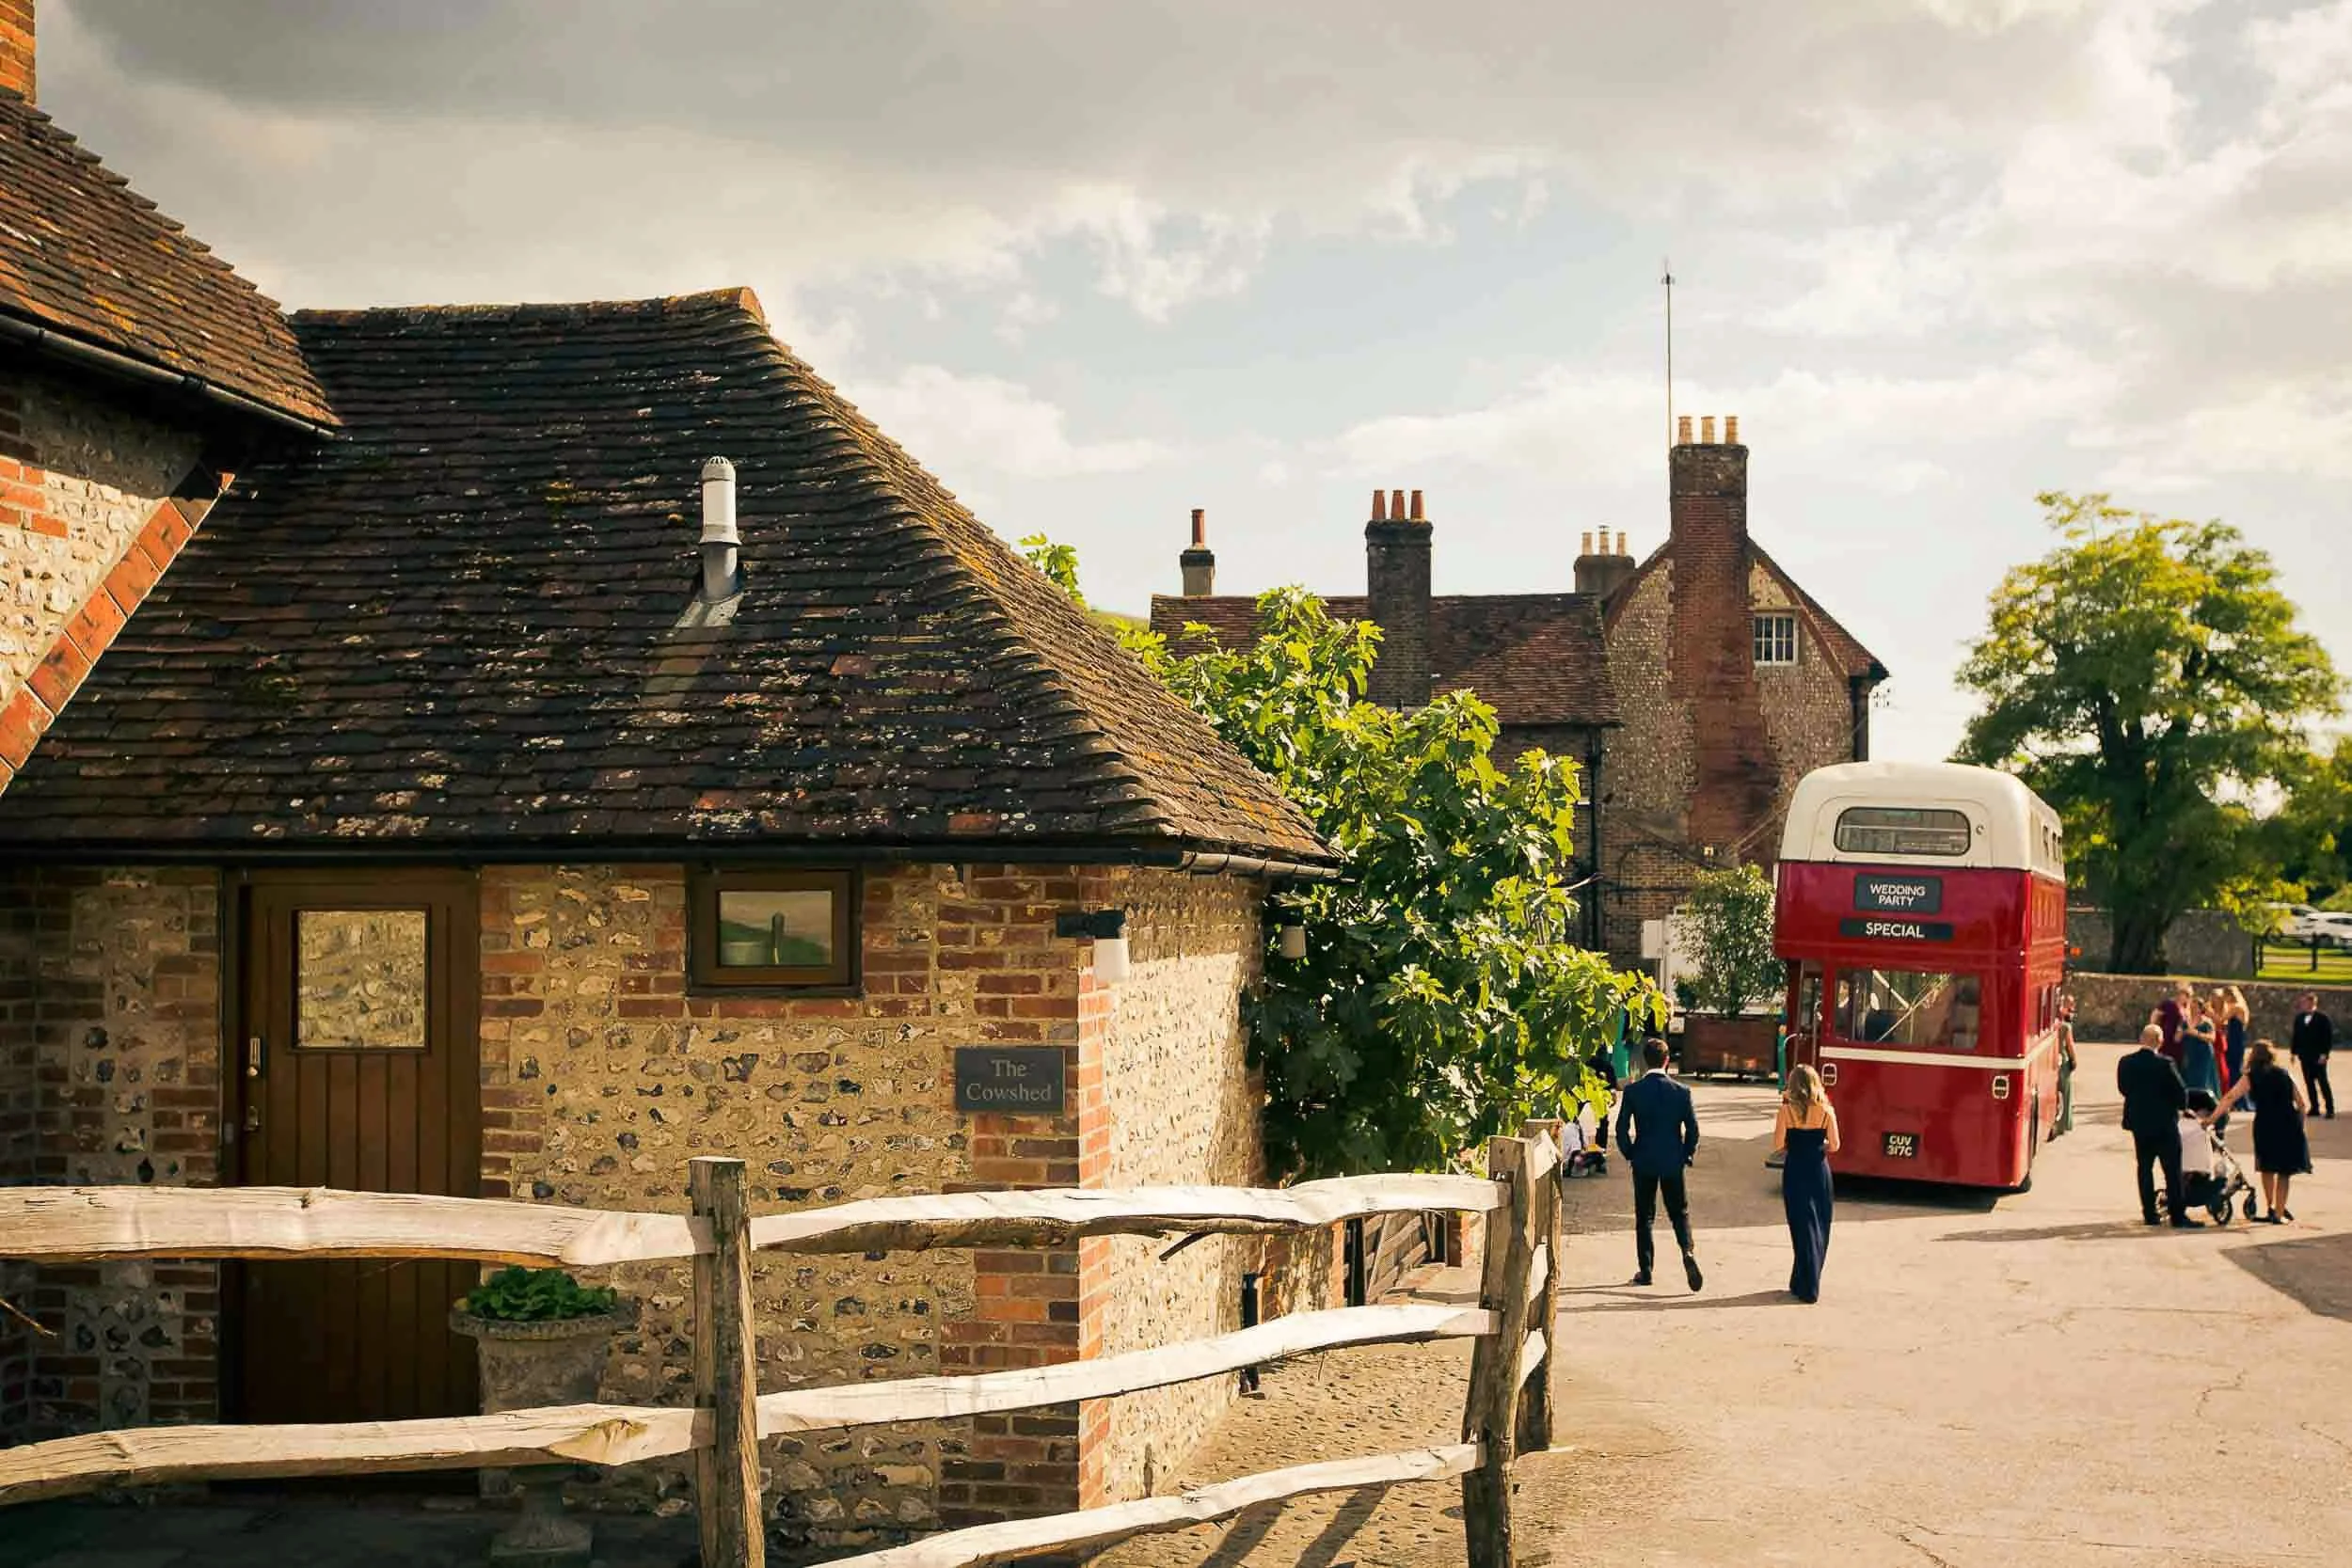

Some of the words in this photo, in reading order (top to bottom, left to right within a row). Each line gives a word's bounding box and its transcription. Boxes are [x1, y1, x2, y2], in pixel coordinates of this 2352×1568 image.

[1869, 883, 1926, 896] WEDDING
[1878, 895, 1915, 907] PARTY
[1866, 922, 1925, 939] SPECIAL
[991, 1059, 1028, 1077] The
[965, 1083, 1052, 1101] Cowshed
[1888, 1135, 1913, 1146] CUV
